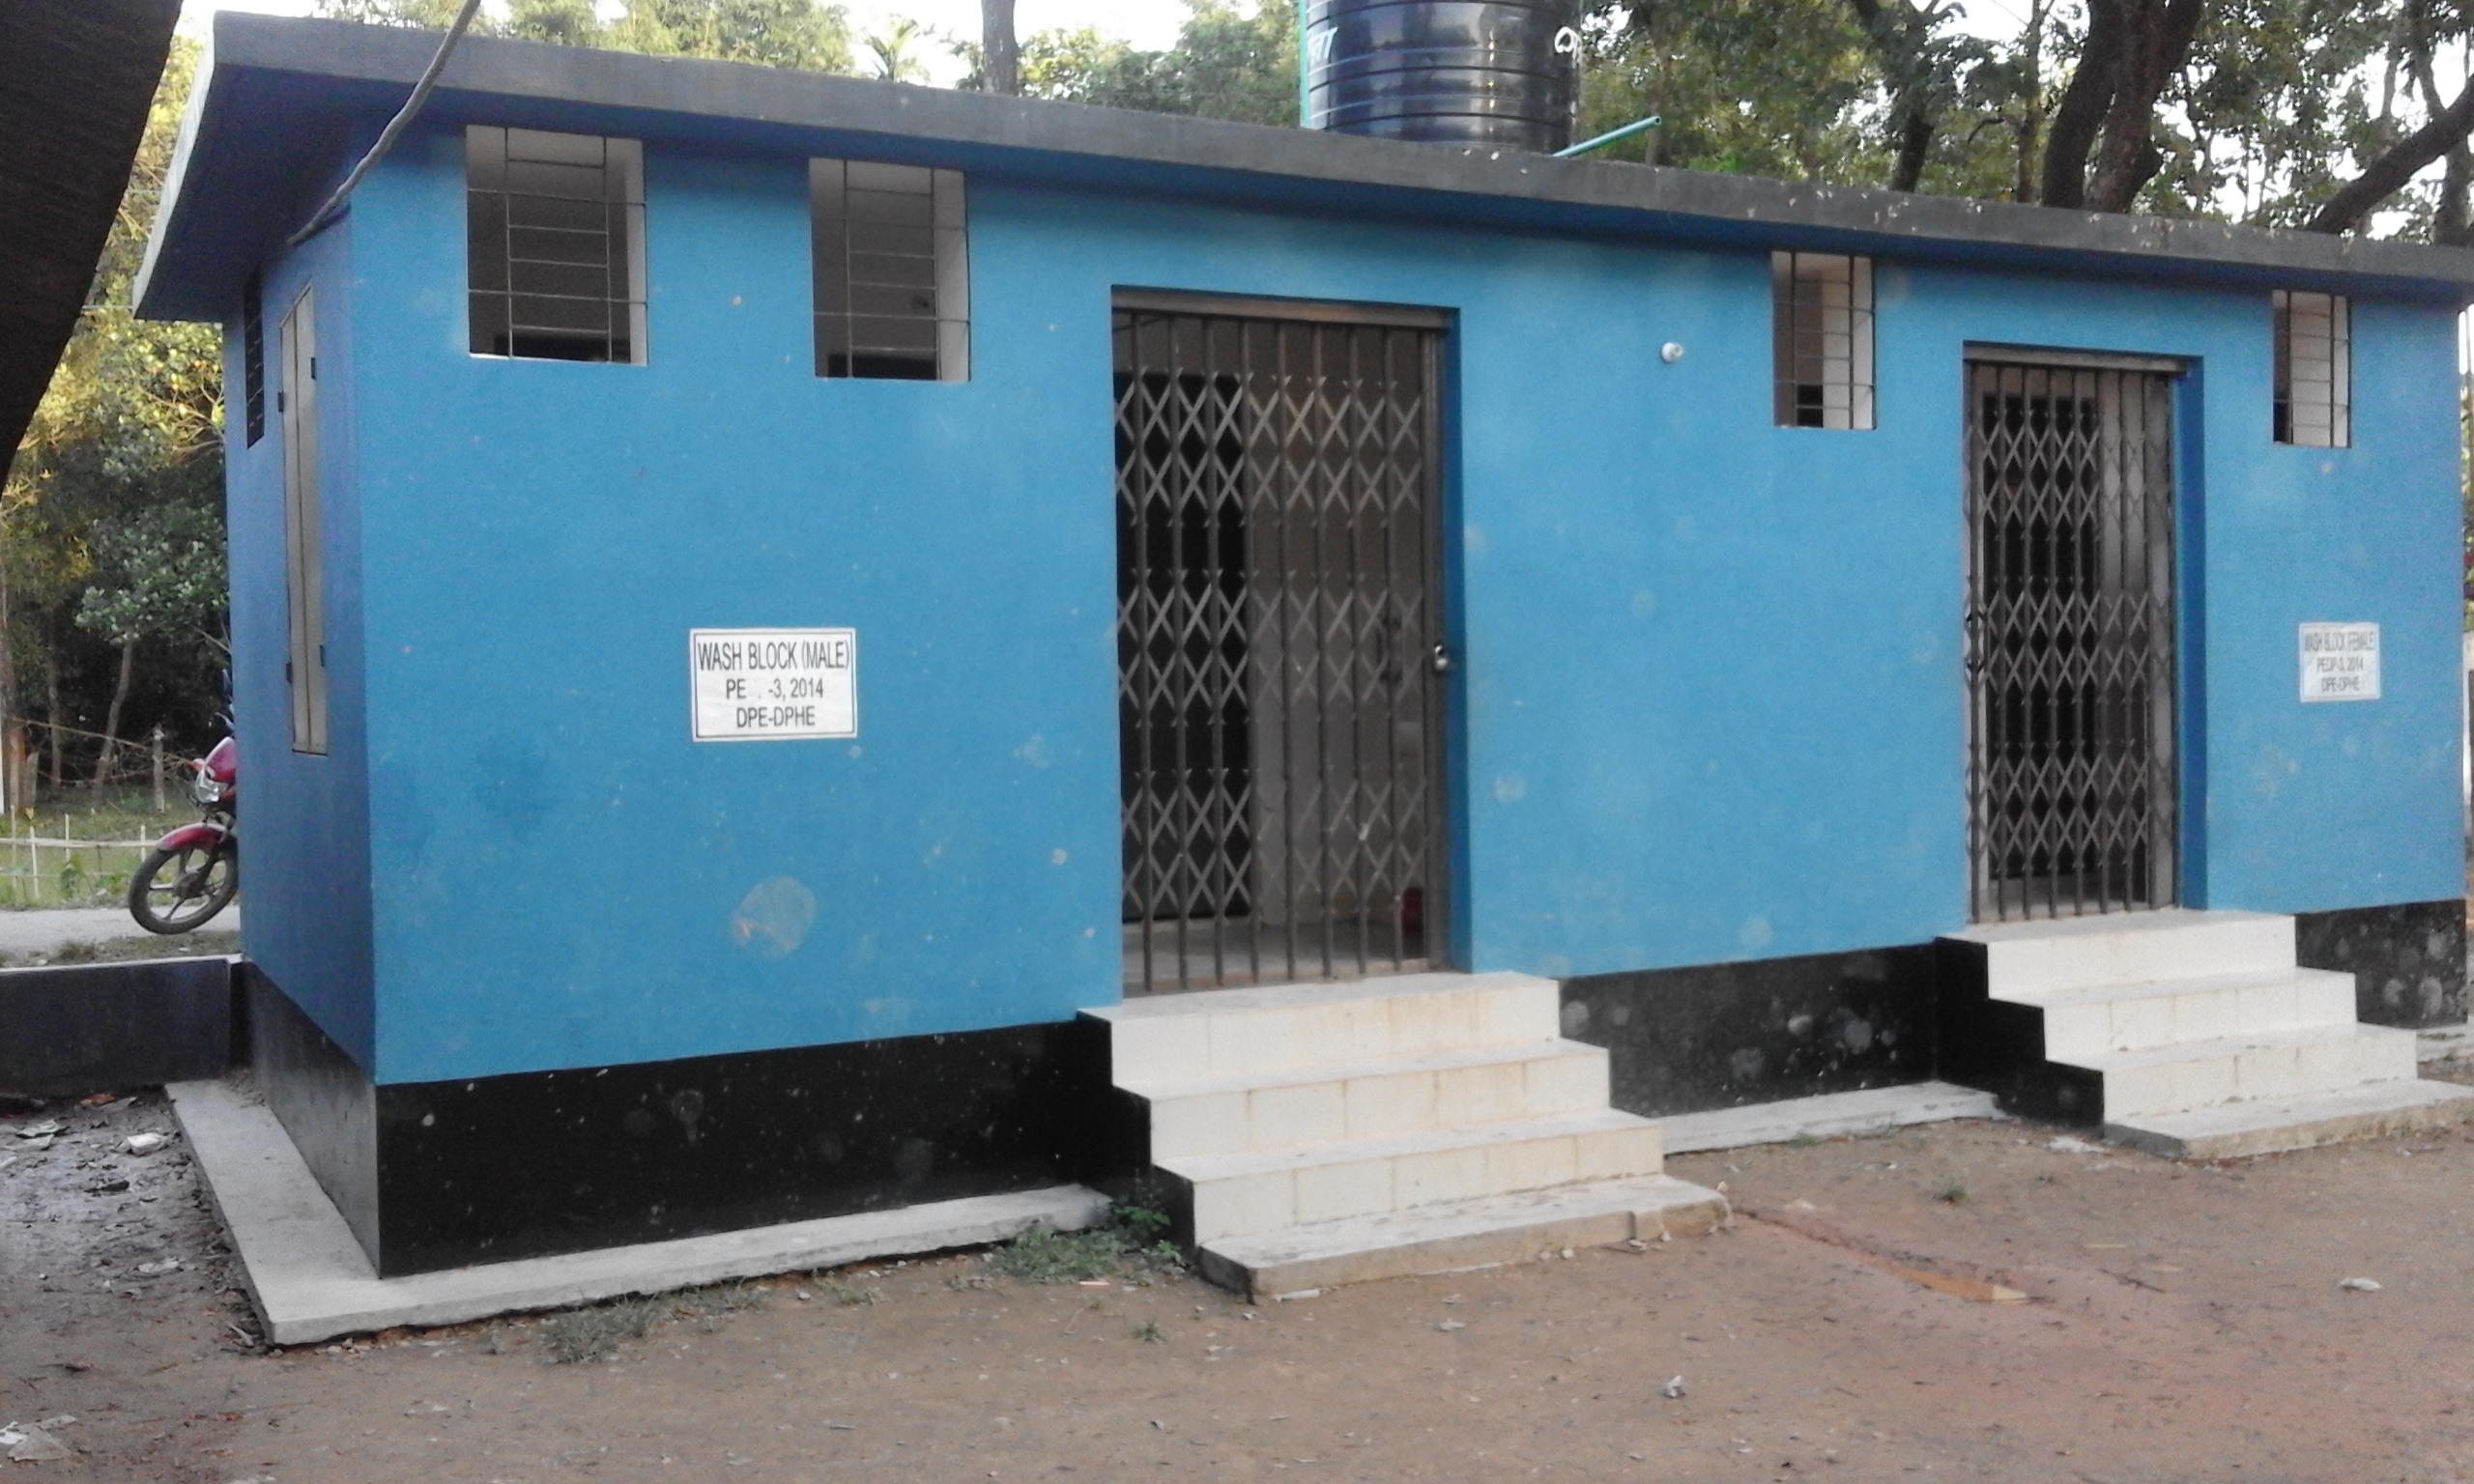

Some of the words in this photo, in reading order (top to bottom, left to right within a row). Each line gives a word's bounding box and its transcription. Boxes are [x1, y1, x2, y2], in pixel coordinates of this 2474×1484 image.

[697, 642, 742, 671] WASH
[748, 641, 797, 670] BLOCK
[801, 639, 849, 671] (MALE)
[790, 676, 824, 699] 2014
[735, 705, 816, 728] DPE-DPHE
